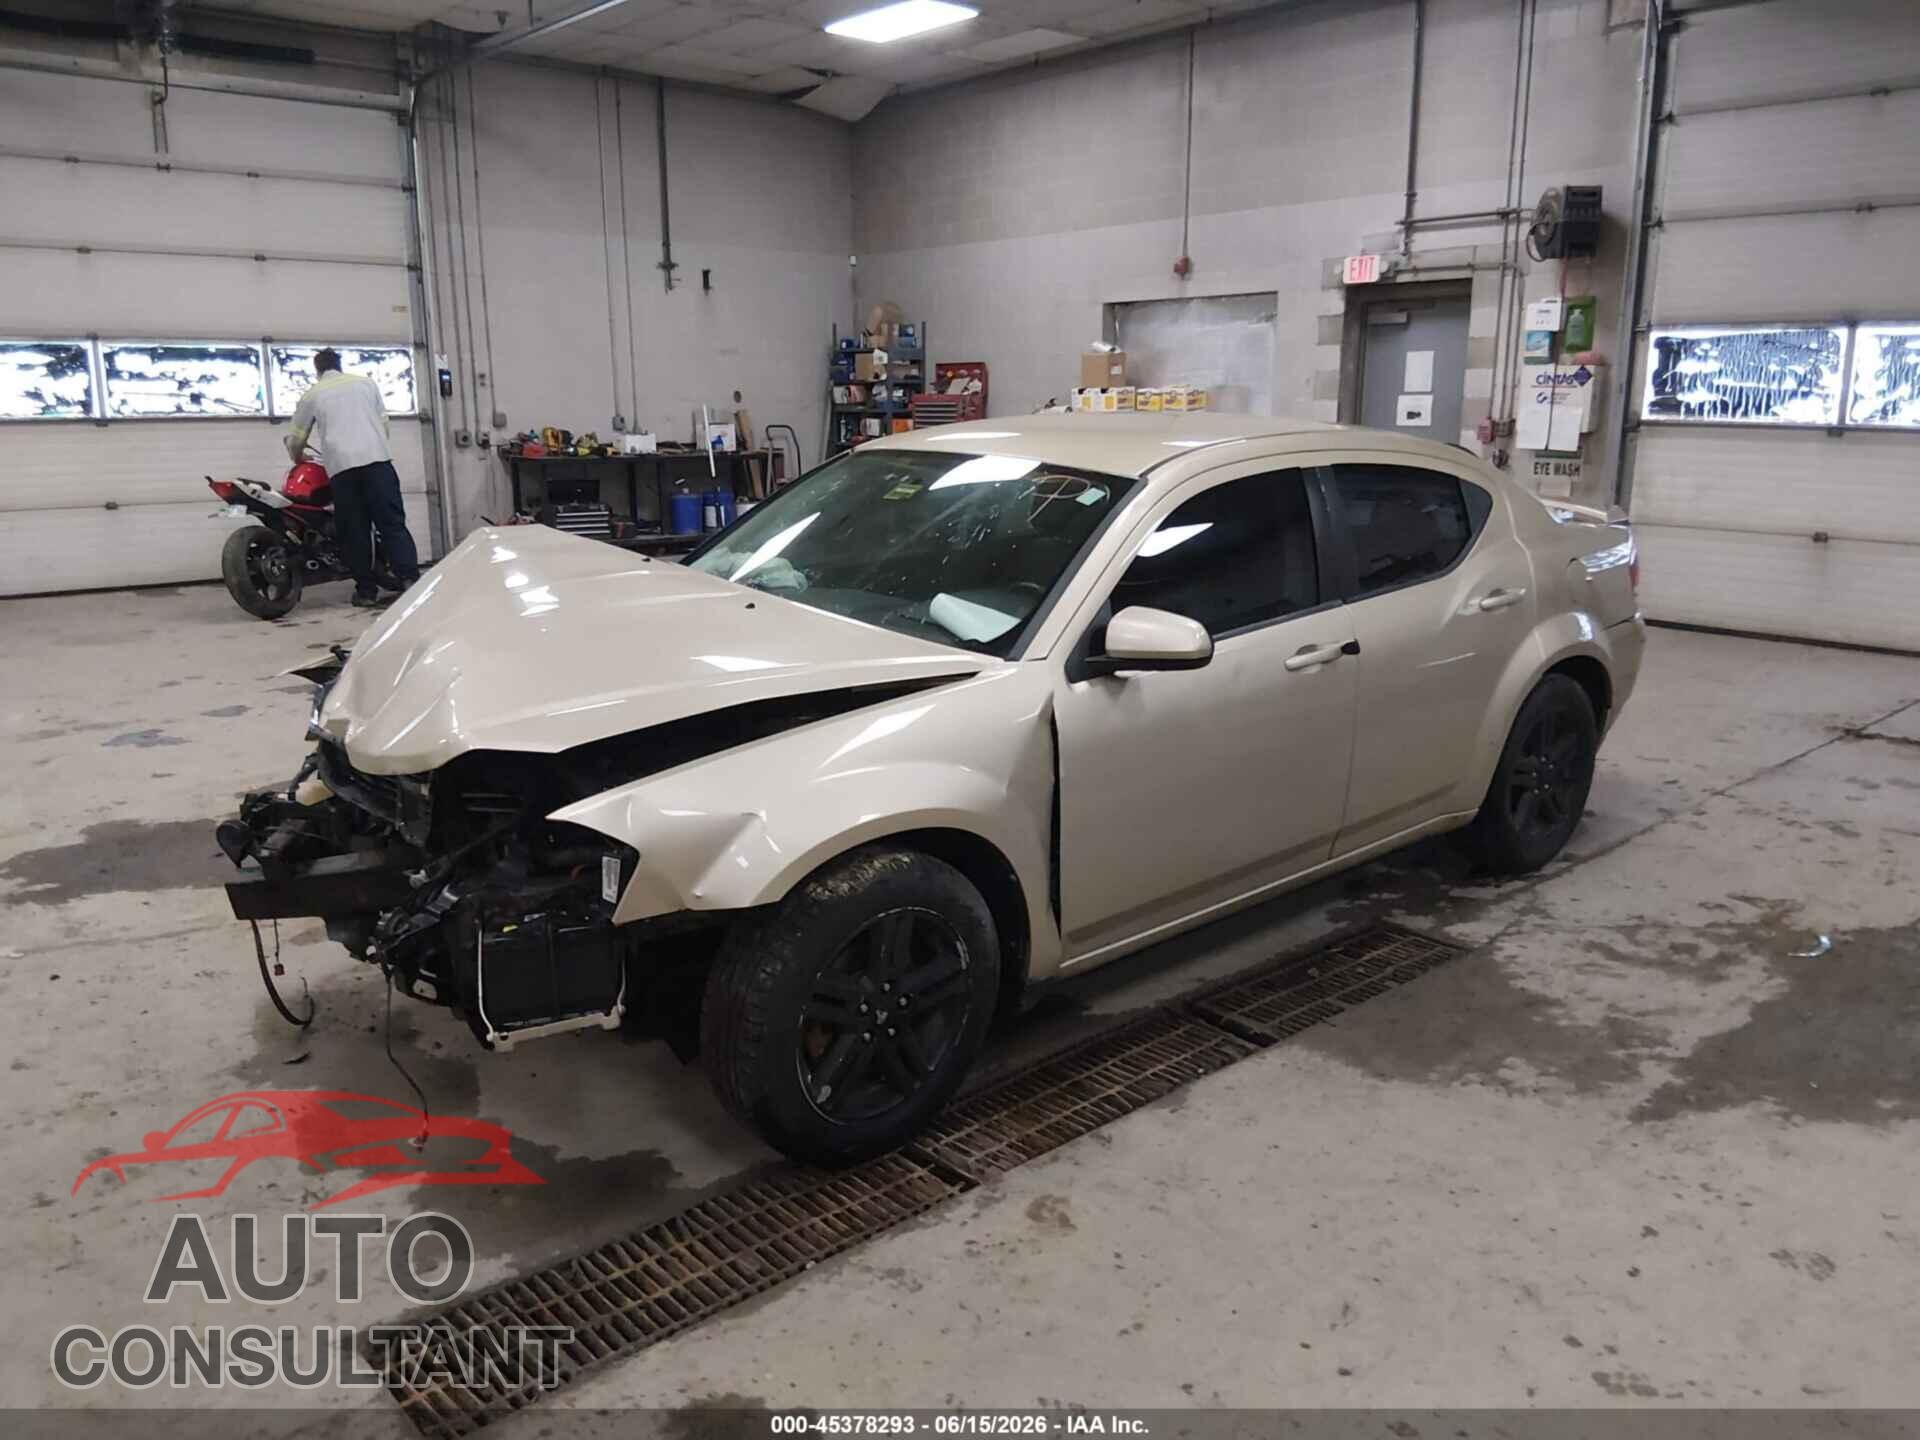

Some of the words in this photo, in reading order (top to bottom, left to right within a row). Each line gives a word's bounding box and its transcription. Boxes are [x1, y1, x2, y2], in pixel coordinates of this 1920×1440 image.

[1350, 256, 1376, 281] EXIT
[1535, 371, 1574, 385] CINTAS
[1534, 462, 1551, 475] EYE
[1553, 463, 1581, 477] WASH
